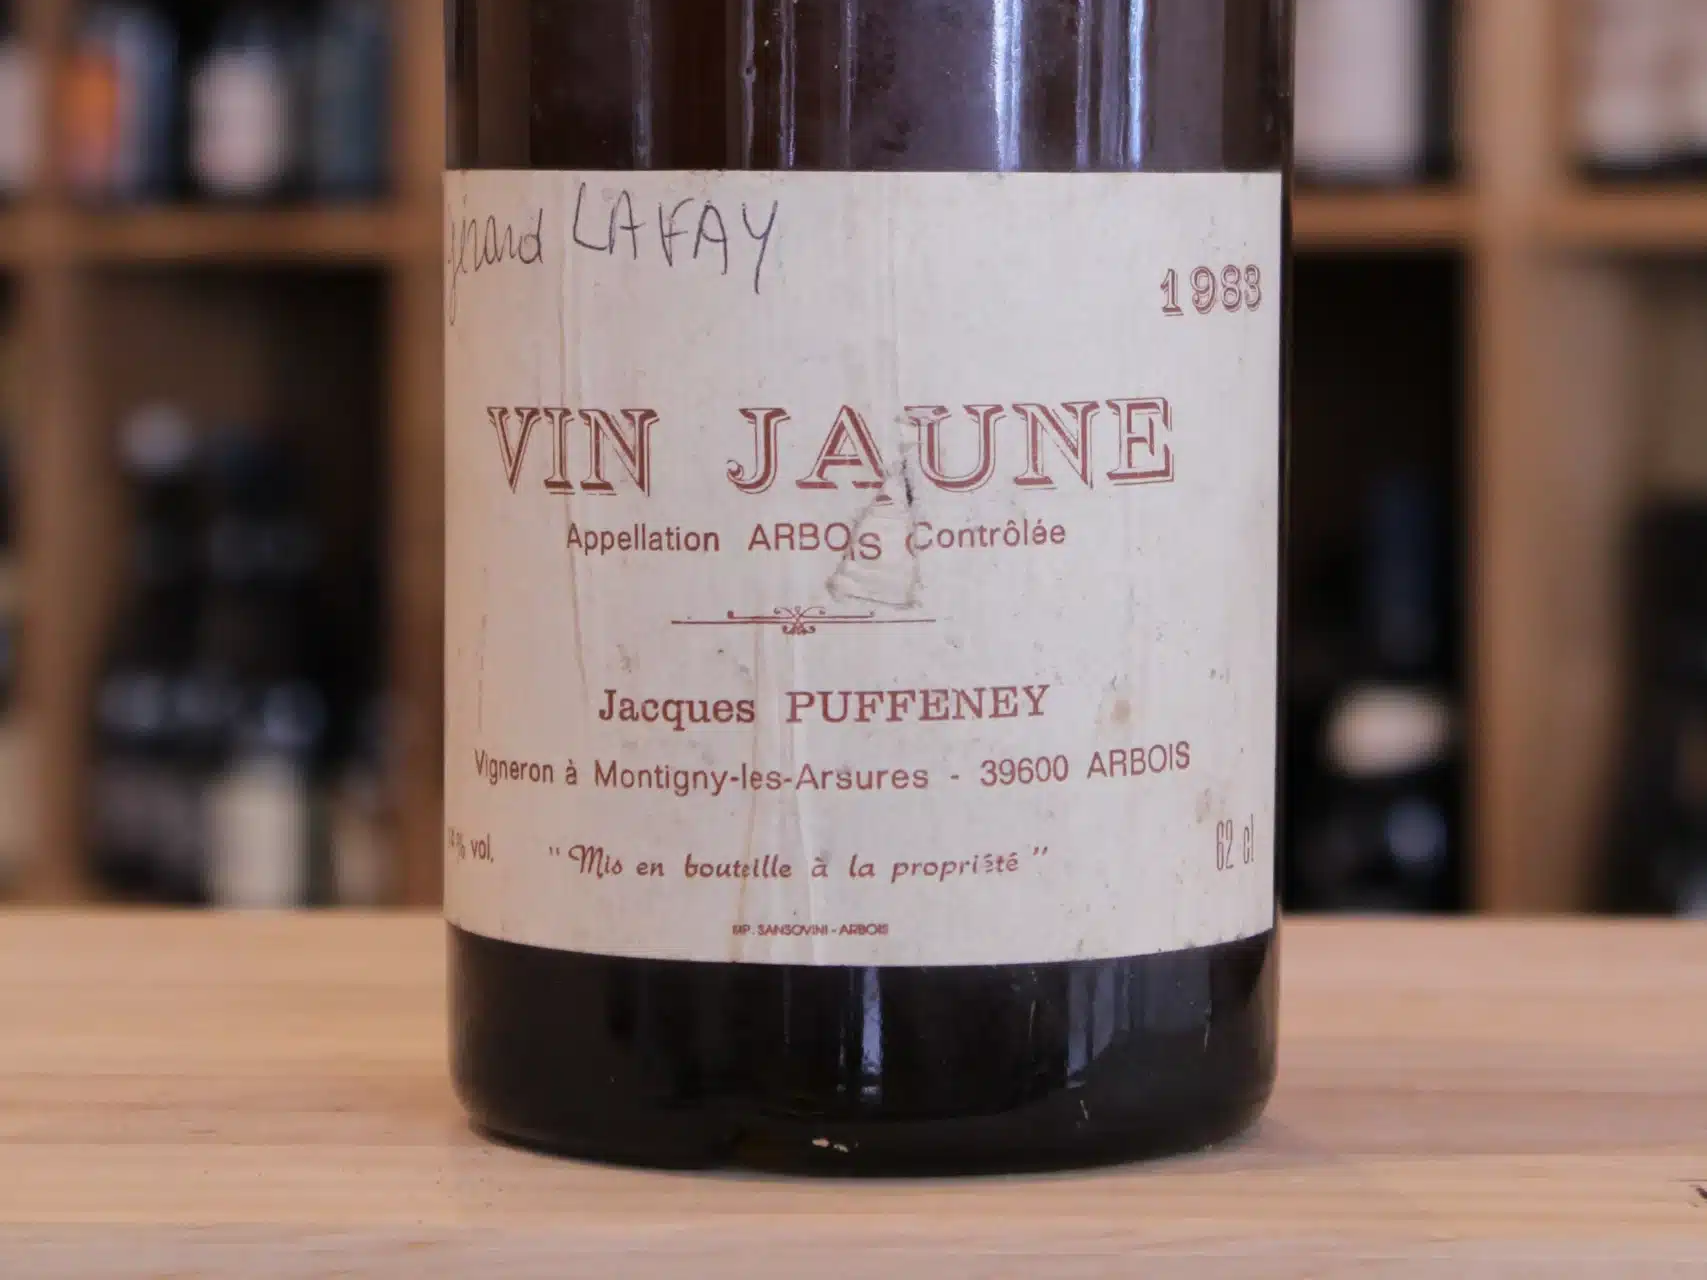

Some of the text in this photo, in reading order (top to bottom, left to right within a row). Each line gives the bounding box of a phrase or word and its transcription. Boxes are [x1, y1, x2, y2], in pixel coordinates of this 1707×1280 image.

[572, 181, 779, 296] LAFAY
[1159, 263, 1262, 317] 1983
[486, 396, 1175, 505] VIN JAUNE
[566, 522, 720, 557] Appellation
[904, 517, 1066, 559] Contrôlée
[598, 683, 1051, 732] Jacques PUFFENEY
[474, 749, 555, 786] Vigneron
[564, 758, 578, 786] à
[594, 759, 929, 798] Montigny-les-Arsures
[979, 754, 1069, 787] 39600
[1086, 740, 1191, 780] ARBOIS
[635, 861, 665, 877] en
[684, 853, 793, 881] bouteille
[811, 855, 829, 878] à
[848, 853, 876, 879] la
[1215, 813, 1255, 873] 62 cl
[838, 922, 889, 936] ARBOIS
